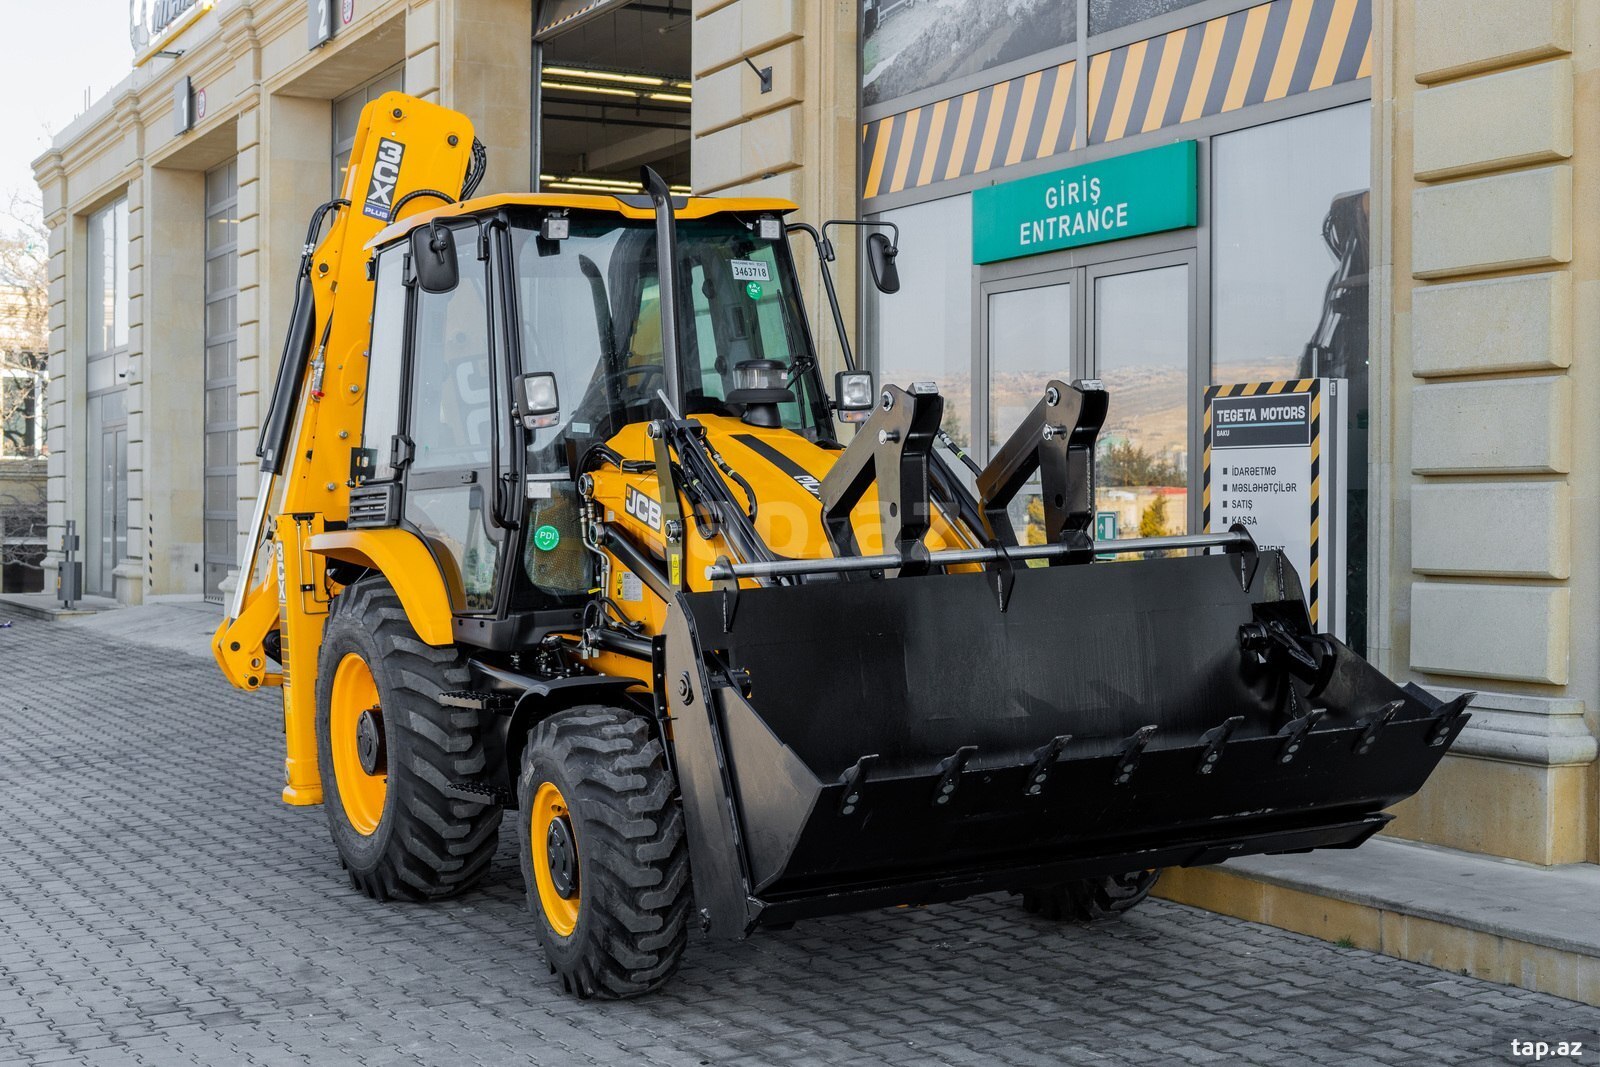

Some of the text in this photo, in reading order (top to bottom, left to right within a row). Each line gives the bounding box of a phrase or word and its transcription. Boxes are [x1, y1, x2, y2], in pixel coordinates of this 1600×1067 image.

[318, 0, 328, 39] 2
[182, 95, 187, 126] 1
[367, 140, 403, 205] 3CX
[1045, 174, 1101, 209] GİRİŞ
[364, 206, 389, 219] PLUS
[1020, 202, 1128, 246] ENTRANCE
[734, 266, 767, 277] 3463718
[1216, 405, 1306, 422] TEGETA MOTORS
[1216, 429, 1230, 437] BAKU
[1231, 465, 1277, 476] İDARƏETMƏ
[1231, 481, 1297, 494] MƏSLƏHƏTÇİLƏR
[625, 487, 662, 530] JCB
[1231, 499, 1253, 510] SATIŞ
[1231, 516, 1258, 525] KASSA
[539, 531, 555, 540] PDI
[276, 542, 287, 599] 3CX
